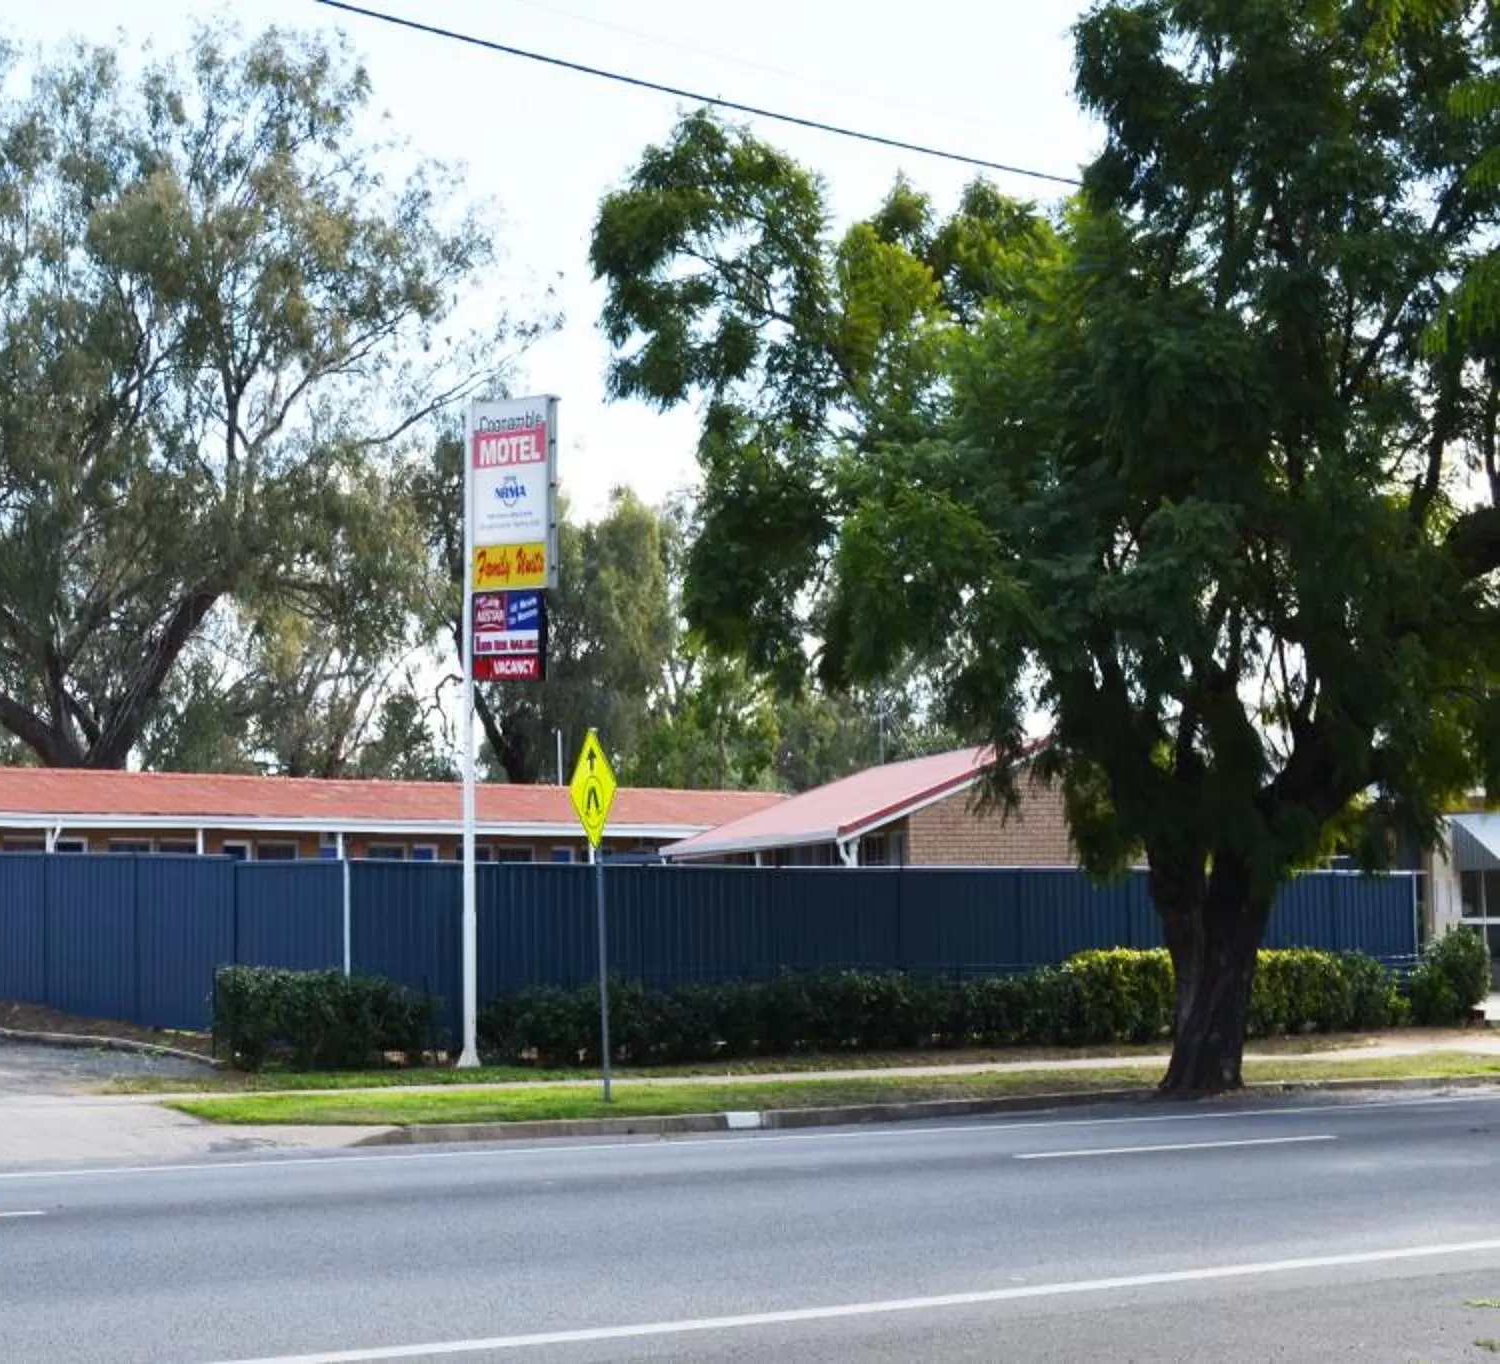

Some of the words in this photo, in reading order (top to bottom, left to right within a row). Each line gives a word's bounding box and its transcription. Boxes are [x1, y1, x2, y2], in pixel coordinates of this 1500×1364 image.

[480, 410, 543, 433] Coonamble
[480, 434, 541, 466] MOTEL
[493, 659, 535, 675] VACANCY
